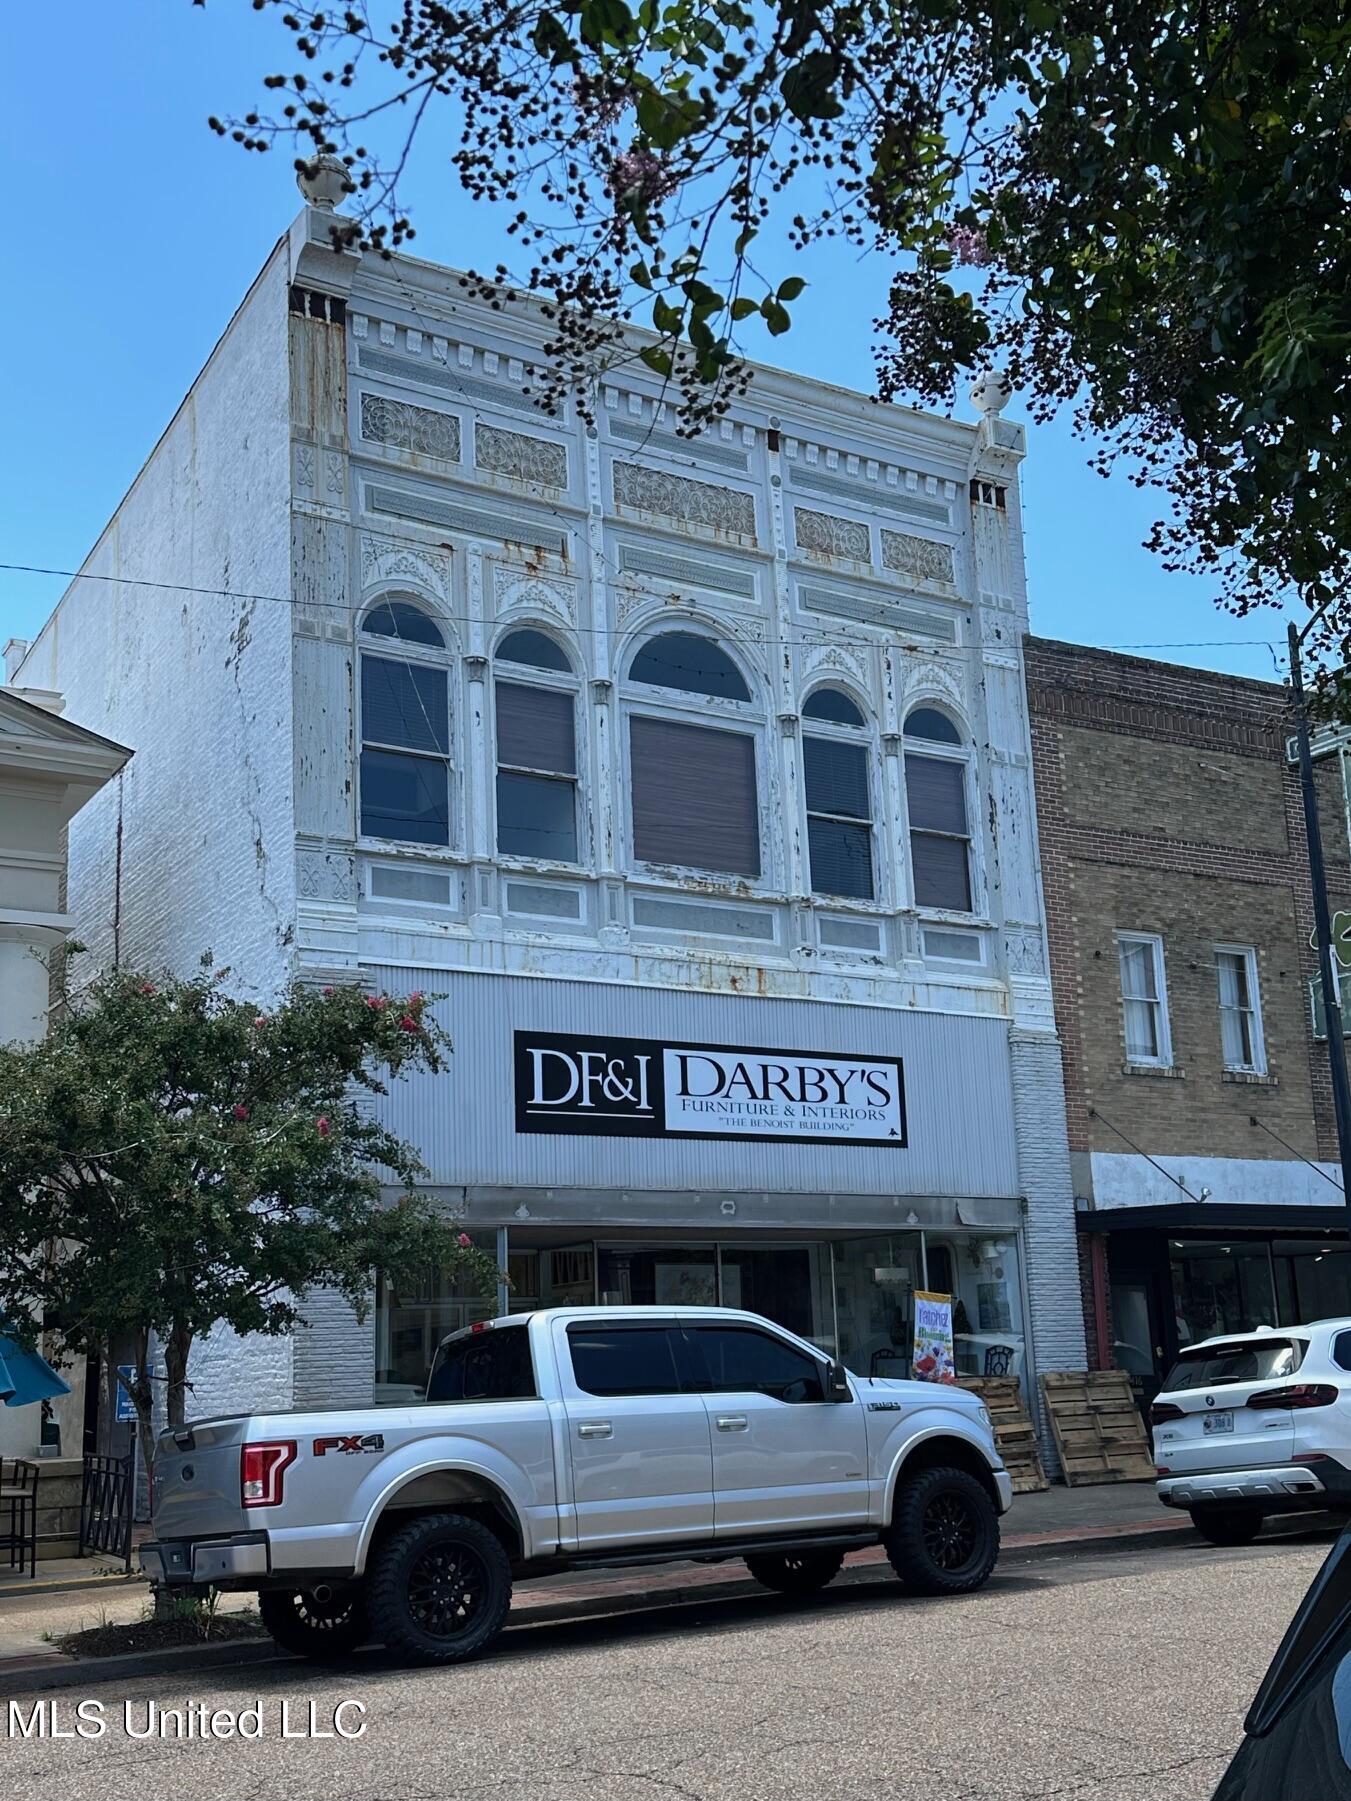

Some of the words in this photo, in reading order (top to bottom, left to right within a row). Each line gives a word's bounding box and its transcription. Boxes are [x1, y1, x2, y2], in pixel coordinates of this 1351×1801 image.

[526, 1048, 653, 1110] DF&I
[675, 1054, 891, 1108] DARBY'S
[682, 1098, 779, 1116] FURNITURE
[784, 1105, 796, 1117] &
[802, 1105, 887, 1121] INTERIORS
[719, 1117, 748, 1127] "THE
[750, 1118, 795, 1129] BENOIST
[799, 1120, 855, 1132] BUILDING"
[313, 1433, 385, 1457] FX4
